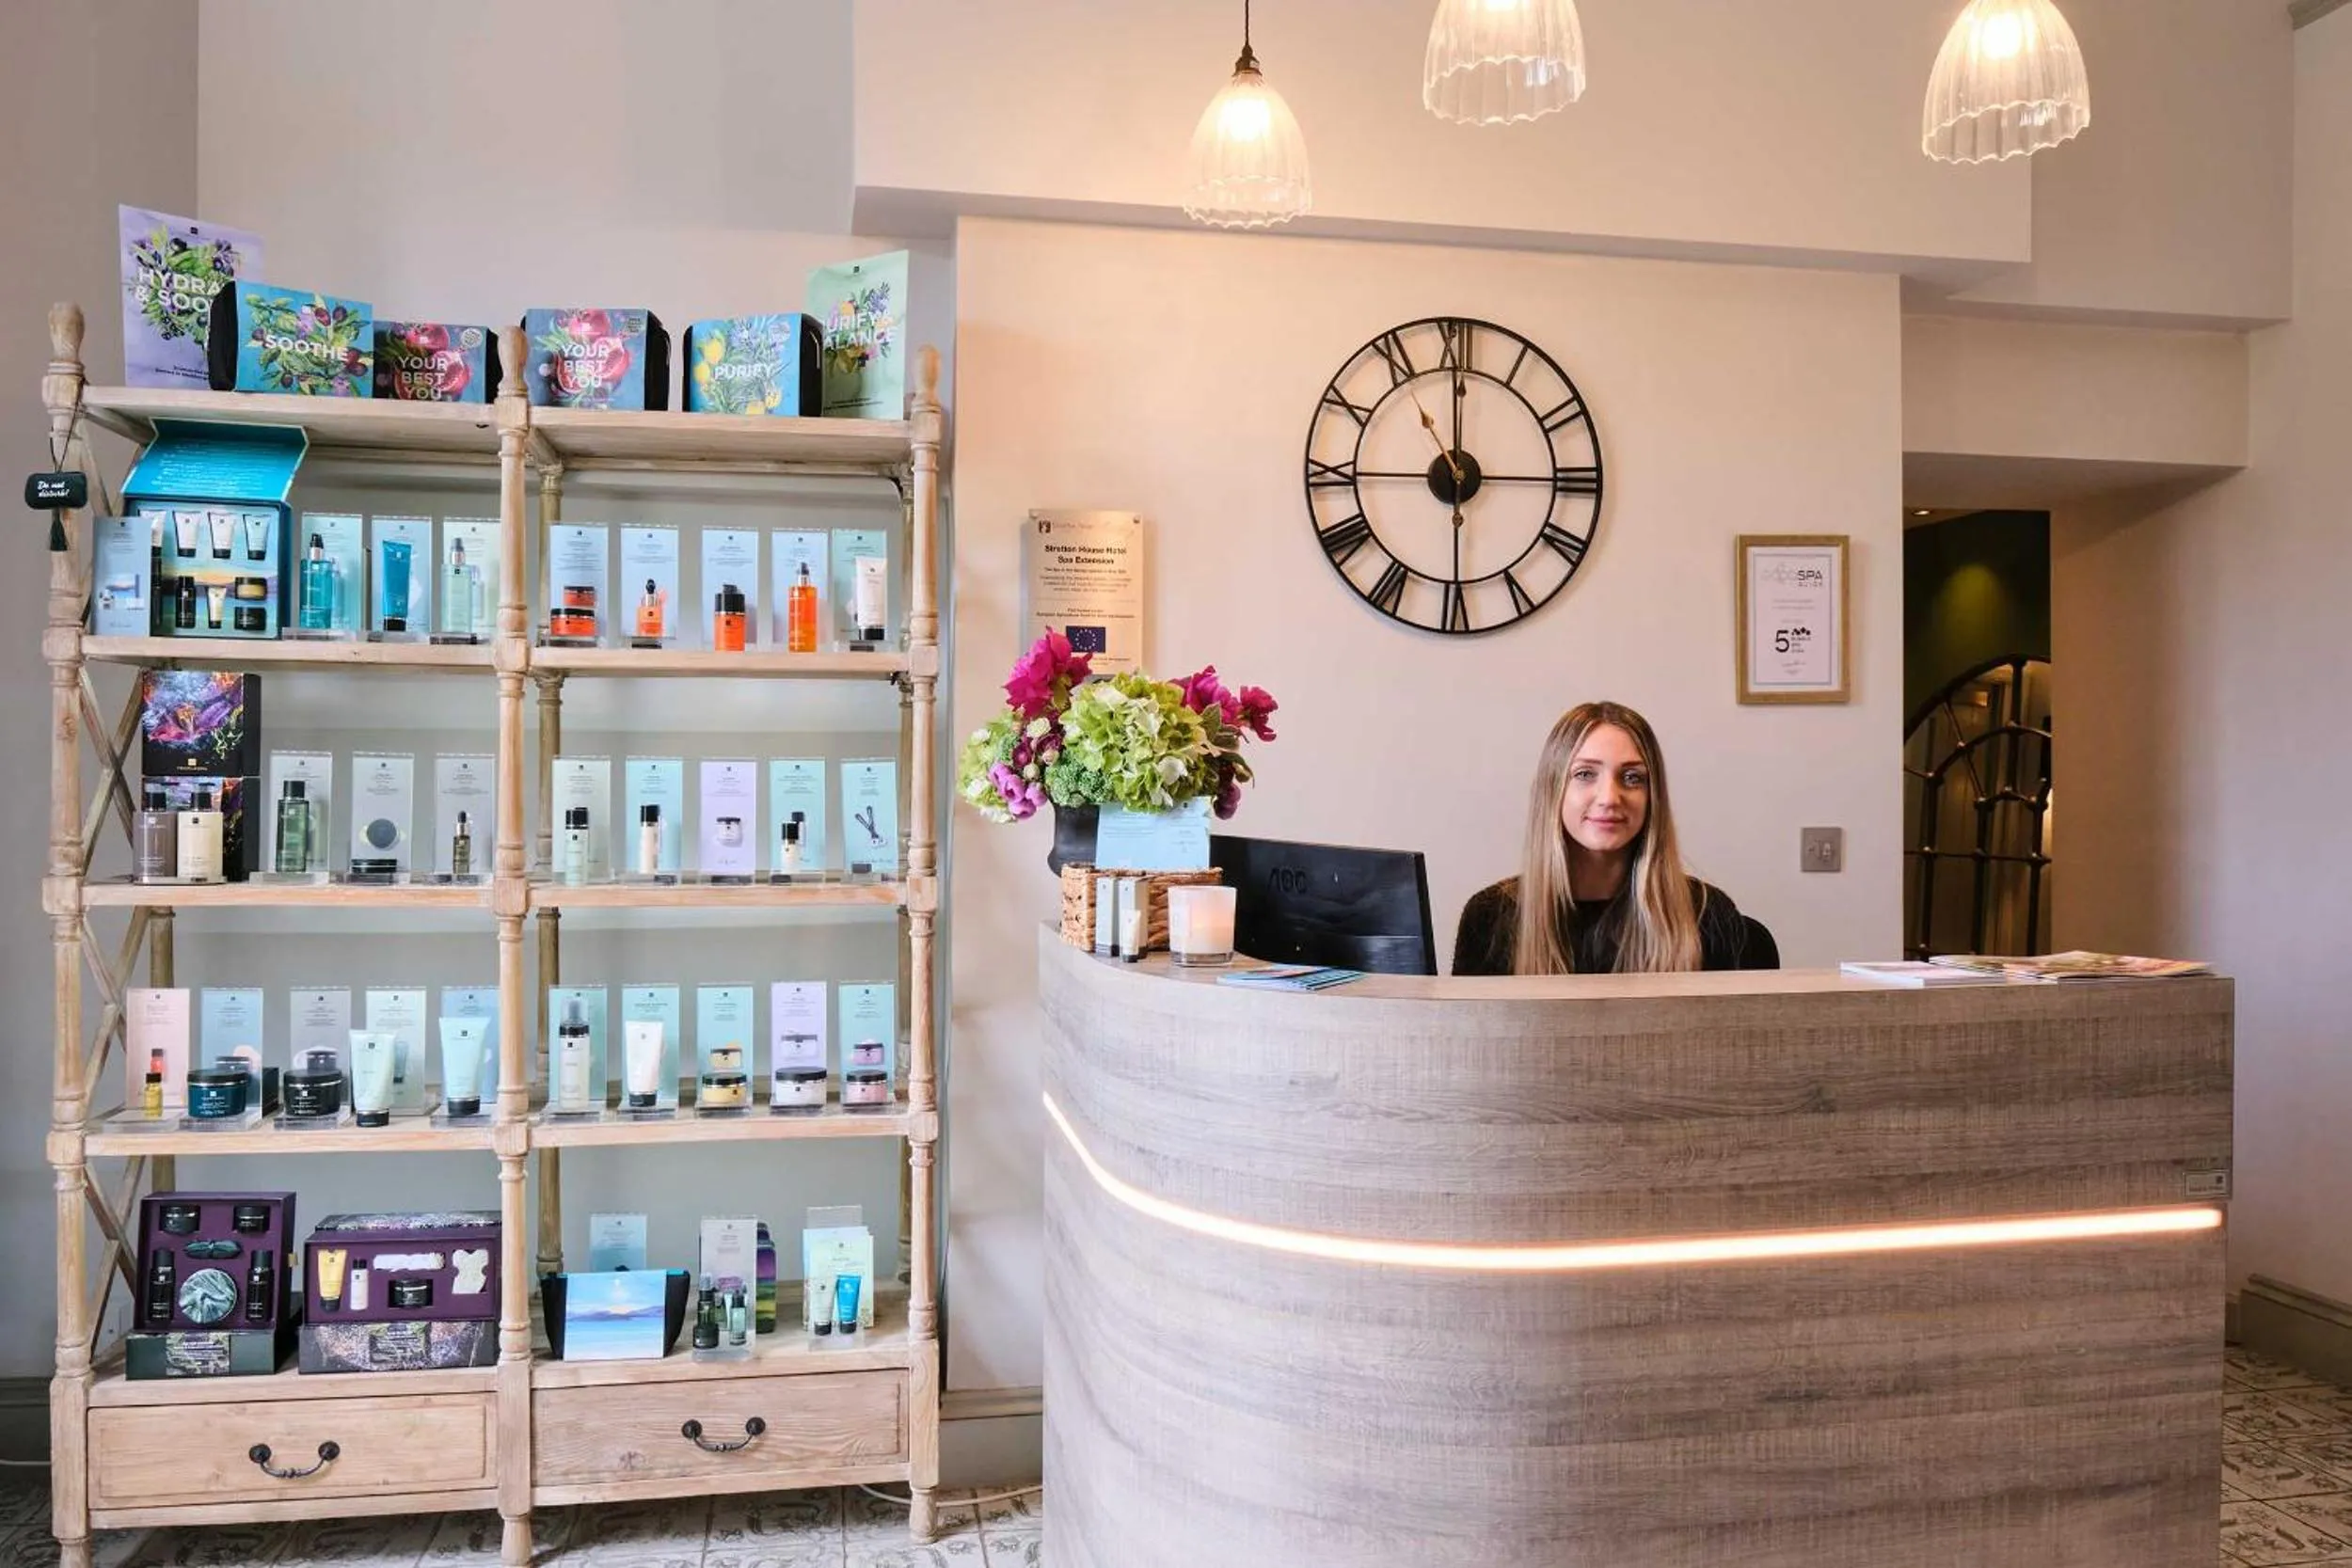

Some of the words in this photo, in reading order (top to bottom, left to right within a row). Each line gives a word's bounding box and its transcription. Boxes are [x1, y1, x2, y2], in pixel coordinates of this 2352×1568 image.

[138, 266, 227, 295] HYDRA
[158, 289, 215, 313] SOO
[263, 334, 349, 362] SOOTHE
[562, 344, 610, 357] YOUR
[399, 356, 448, 371] YOUR
[564, 360, 607, 373] BEST
[714, 363, 774, 379] PURIFY
[402, 372, 445, 385] BEST
[568, 375, 603, 388] YOU
[404, 386, 441, 400] YOU
[1798, 569, 1822, 581] SPA
[1775, 629, 1790, 654] 5
